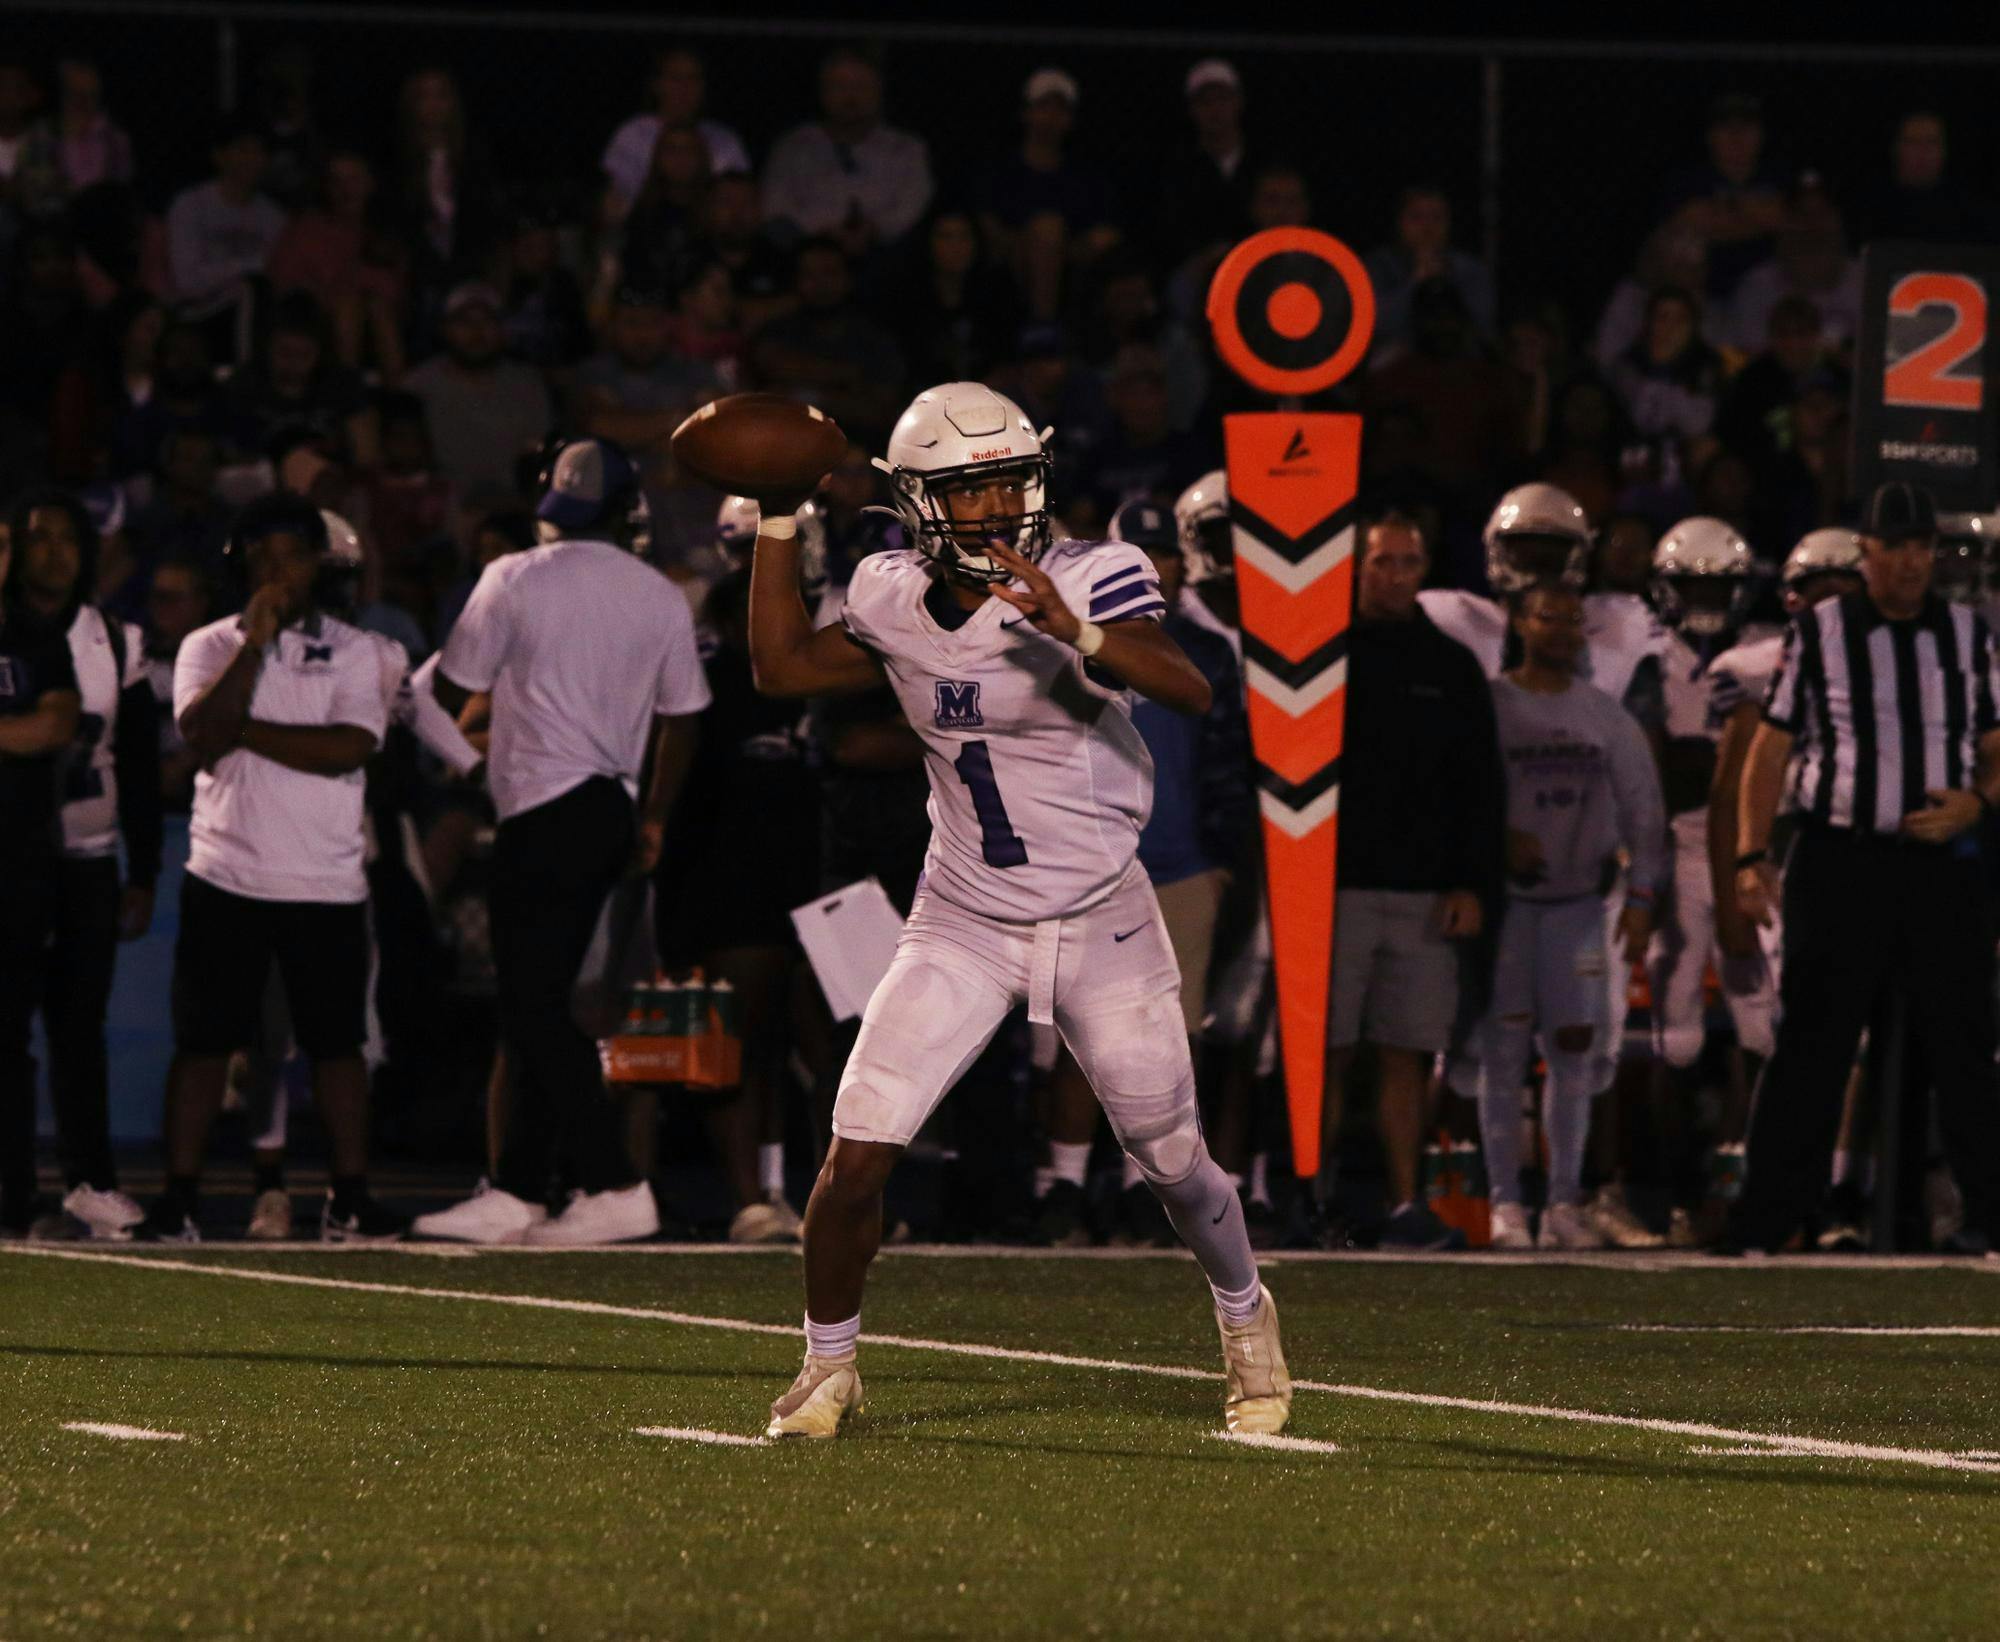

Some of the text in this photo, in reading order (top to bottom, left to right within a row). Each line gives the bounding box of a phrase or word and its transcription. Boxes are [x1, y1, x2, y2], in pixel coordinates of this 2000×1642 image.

[1881, 271, 1989, 412] 2
[971, 447, 1012, 461] Riddell
[935, 681, 980, 719] M
[954, 741, 1029, 868] 1
